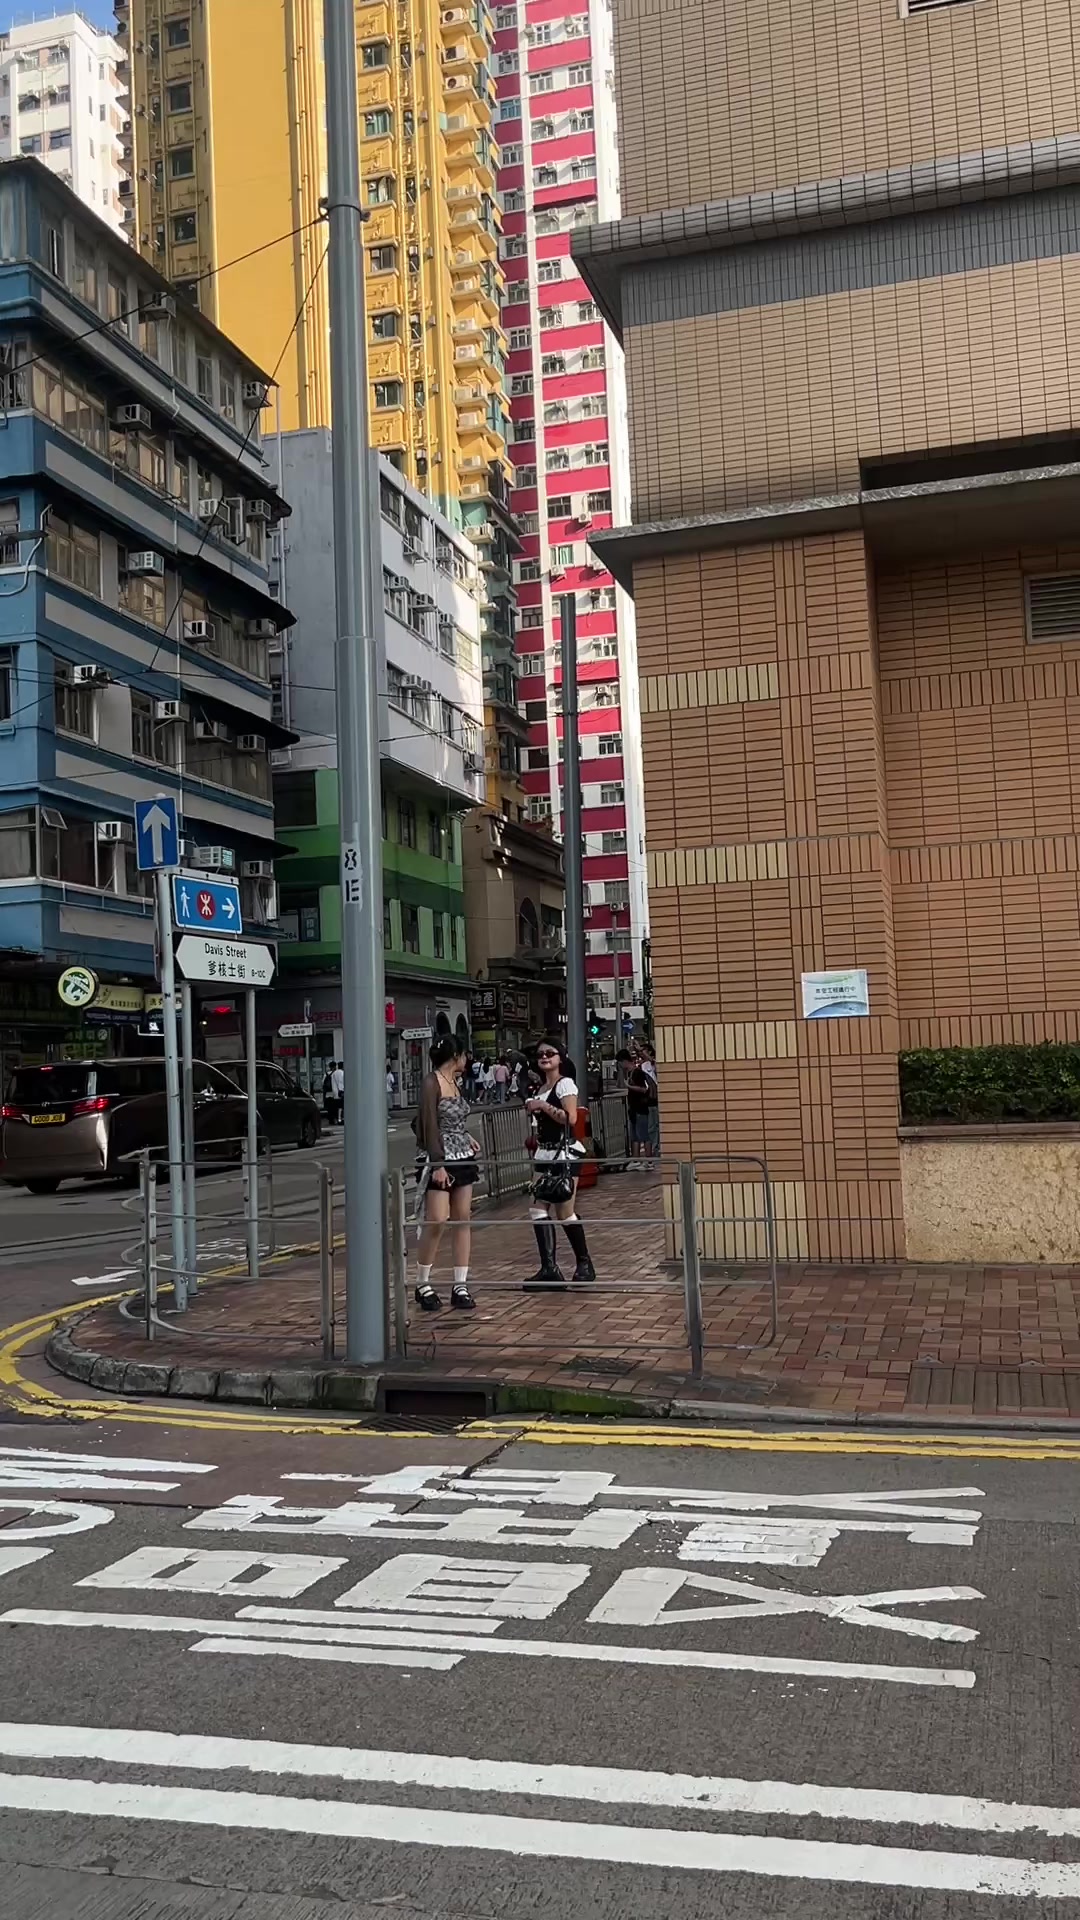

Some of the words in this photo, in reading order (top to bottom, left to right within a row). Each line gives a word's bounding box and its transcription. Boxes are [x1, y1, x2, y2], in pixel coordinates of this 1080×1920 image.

[205, 943, 223, 956] Davis
[226, 945, 247, 959] Street
[208, 960, 246, 979] 爹核士街
